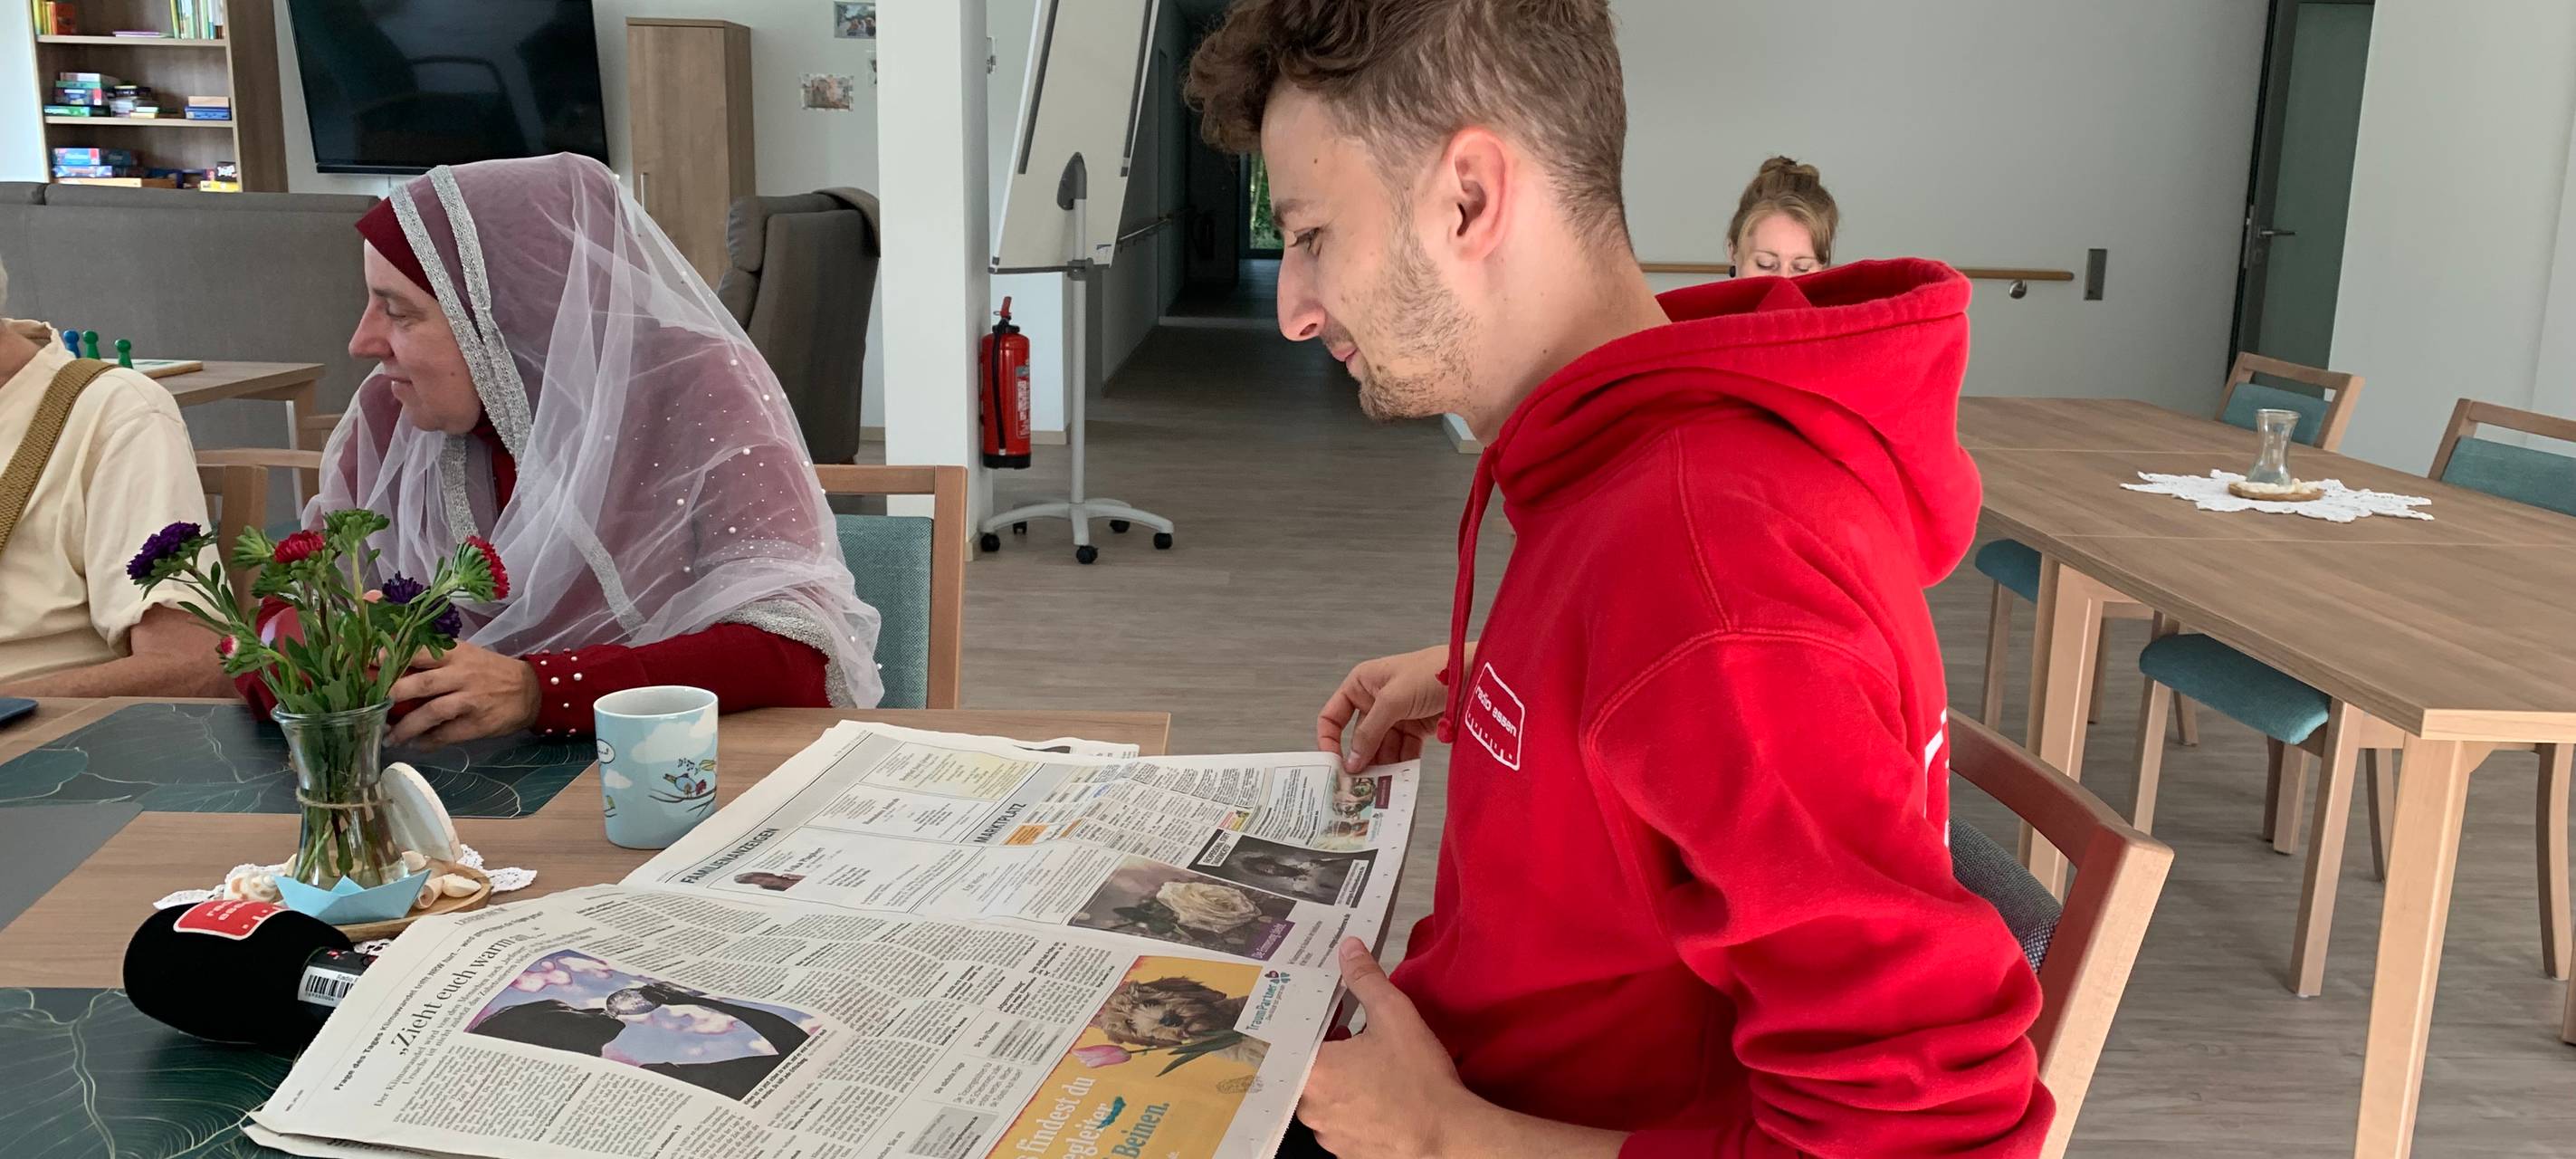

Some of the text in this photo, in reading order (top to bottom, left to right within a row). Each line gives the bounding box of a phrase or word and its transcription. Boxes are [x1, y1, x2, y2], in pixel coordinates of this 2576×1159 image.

[1491, 706, 1518, 738] essen
[973, 803, 1027, 843] MARKTPLATZ
[681, 827, 779, 884] FAMILIENANZEIGEN
[436, 970, 477, 1001] euch
[469, 938, 516, 967] warm
[333, 1069, 354, 1090] Frage
[352, 1054, 367, 1068] des
[362, 1032, 384, 1054] Tages
[379, 989, 415, 1030] Klimawandel
[427, 963, 444, 978] NRW
[1245, 983, 1277, 1030] TraumPartner
[386, 1046, 426, 1091] Klimawandel
[425, 1030, 440, 1047] wird
[435, 1028, 453, 1048] nicht
[1016, 1096, 1082, 1154] findest
[1061, 1077, 1097, 1097] du
[1111, 1102, 1170, 1159] Beinen.
